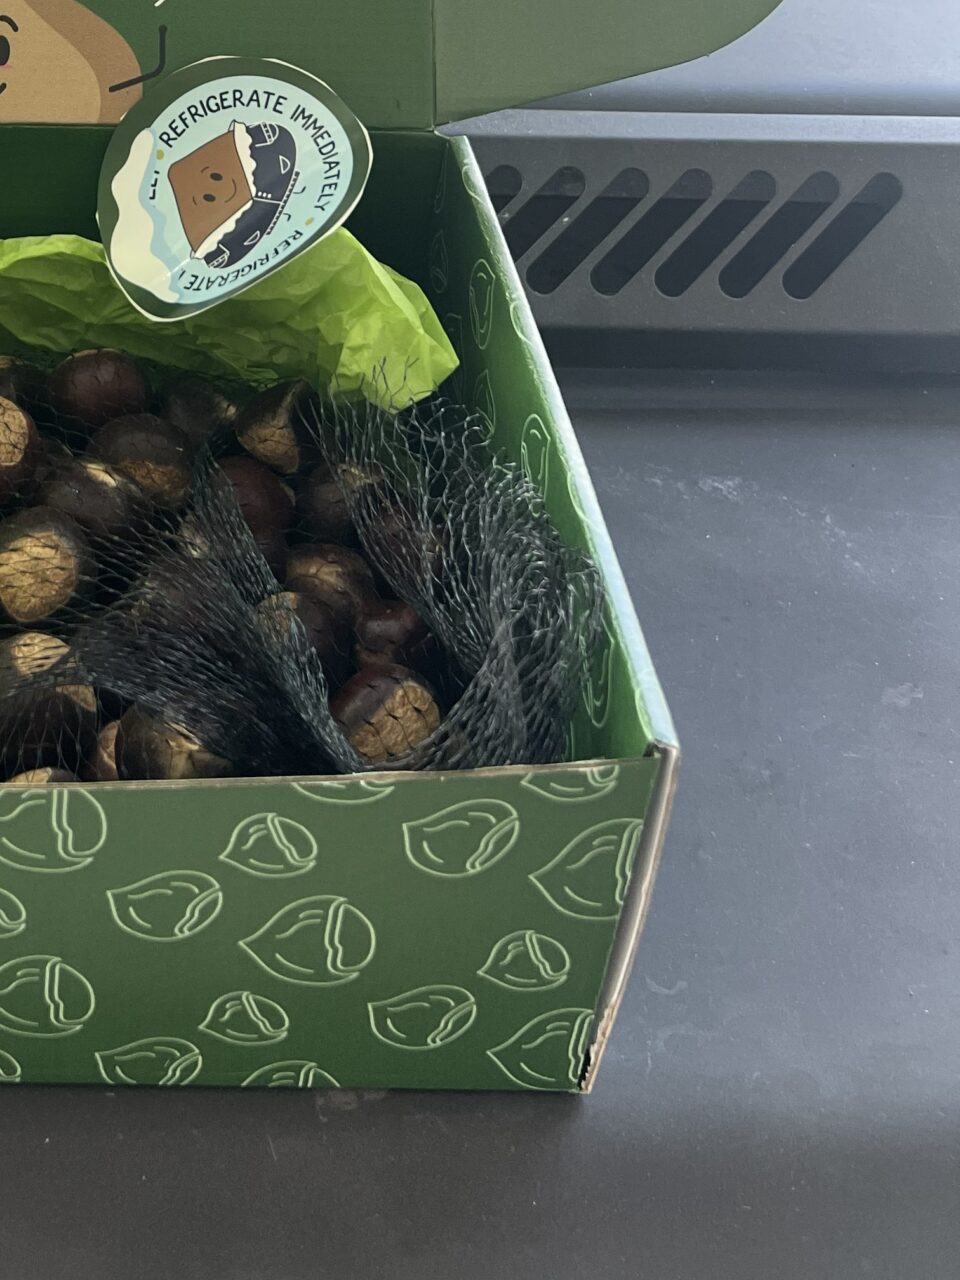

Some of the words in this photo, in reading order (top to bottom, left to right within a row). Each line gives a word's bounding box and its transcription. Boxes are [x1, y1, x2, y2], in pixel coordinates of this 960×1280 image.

[159, 89, 288, 148] REFRIGERATE
[290, 104, 342, 212] IMMEDIATELY
[183, 229, 304, 292] REFRIGERATE
